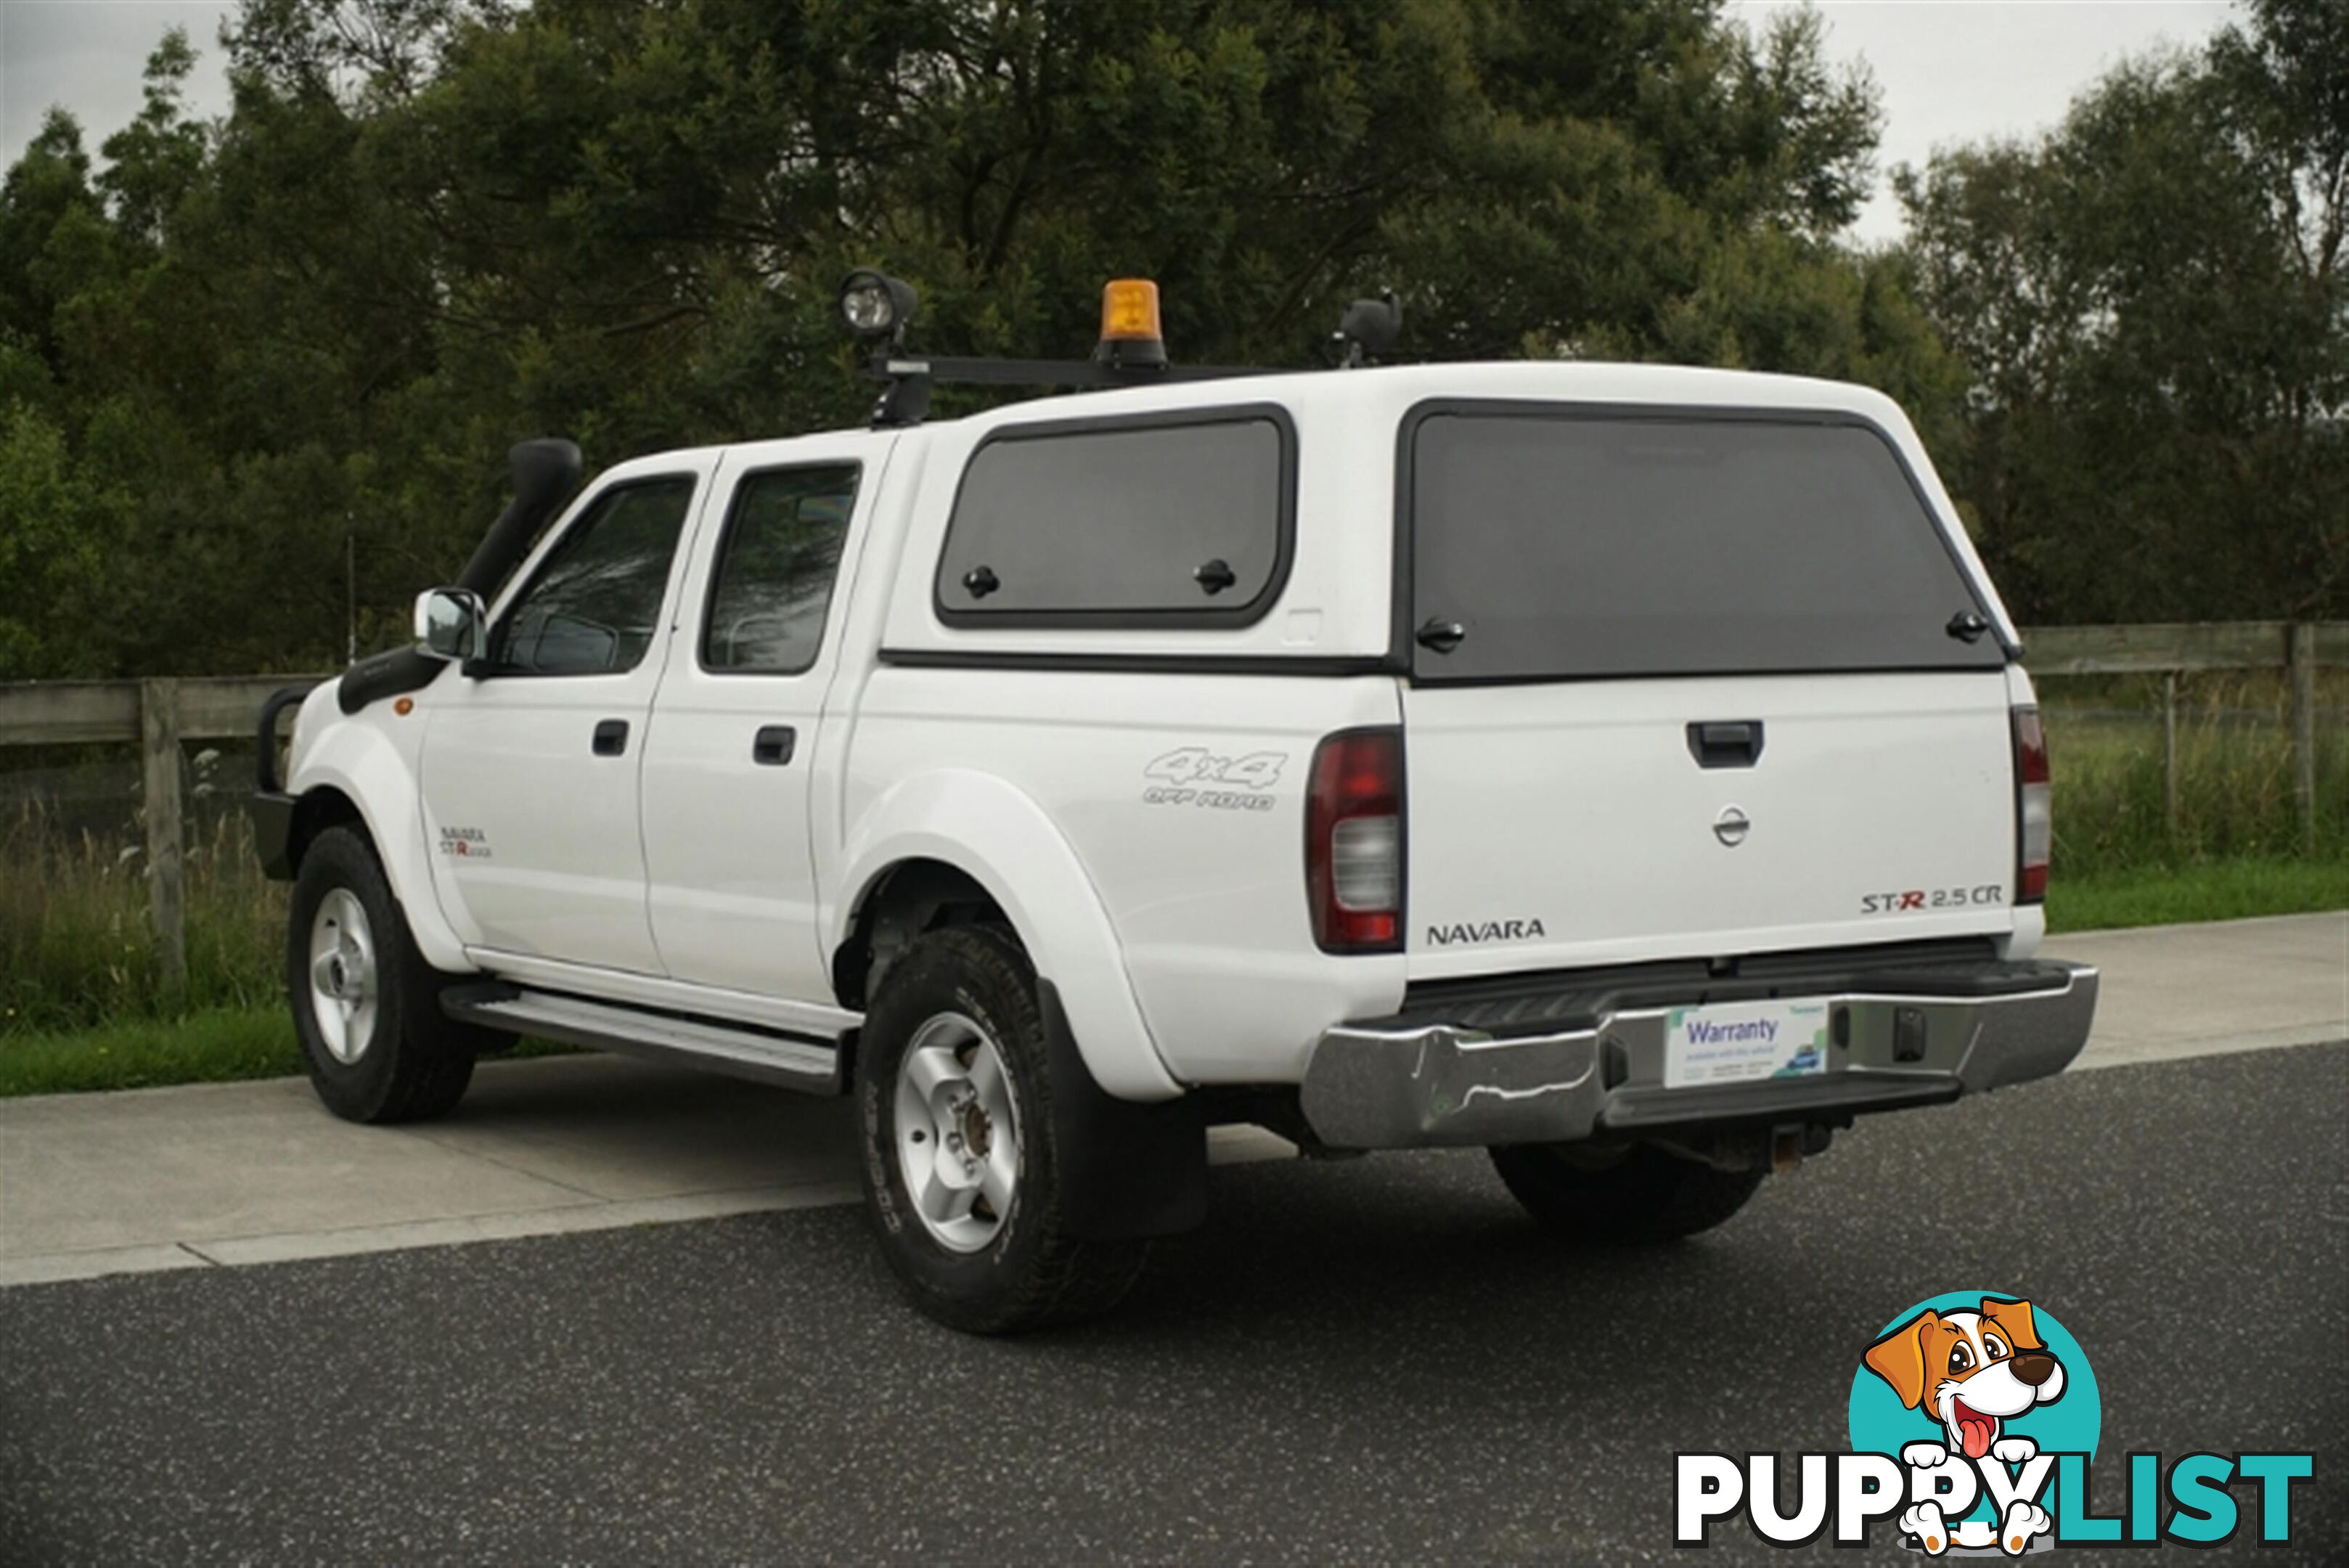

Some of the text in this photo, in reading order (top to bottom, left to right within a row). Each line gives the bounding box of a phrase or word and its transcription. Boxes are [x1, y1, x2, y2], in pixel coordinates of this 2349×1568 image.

[1143, 786, 1275, 810] OFF ROAD
[1932, 889, 1967, 907] 2.5
[1972, 885, 2002, 904] CR
[1427, 919, 1545, 945] NAVARA
[1687, 1018, 1779, 1044] Warranty
